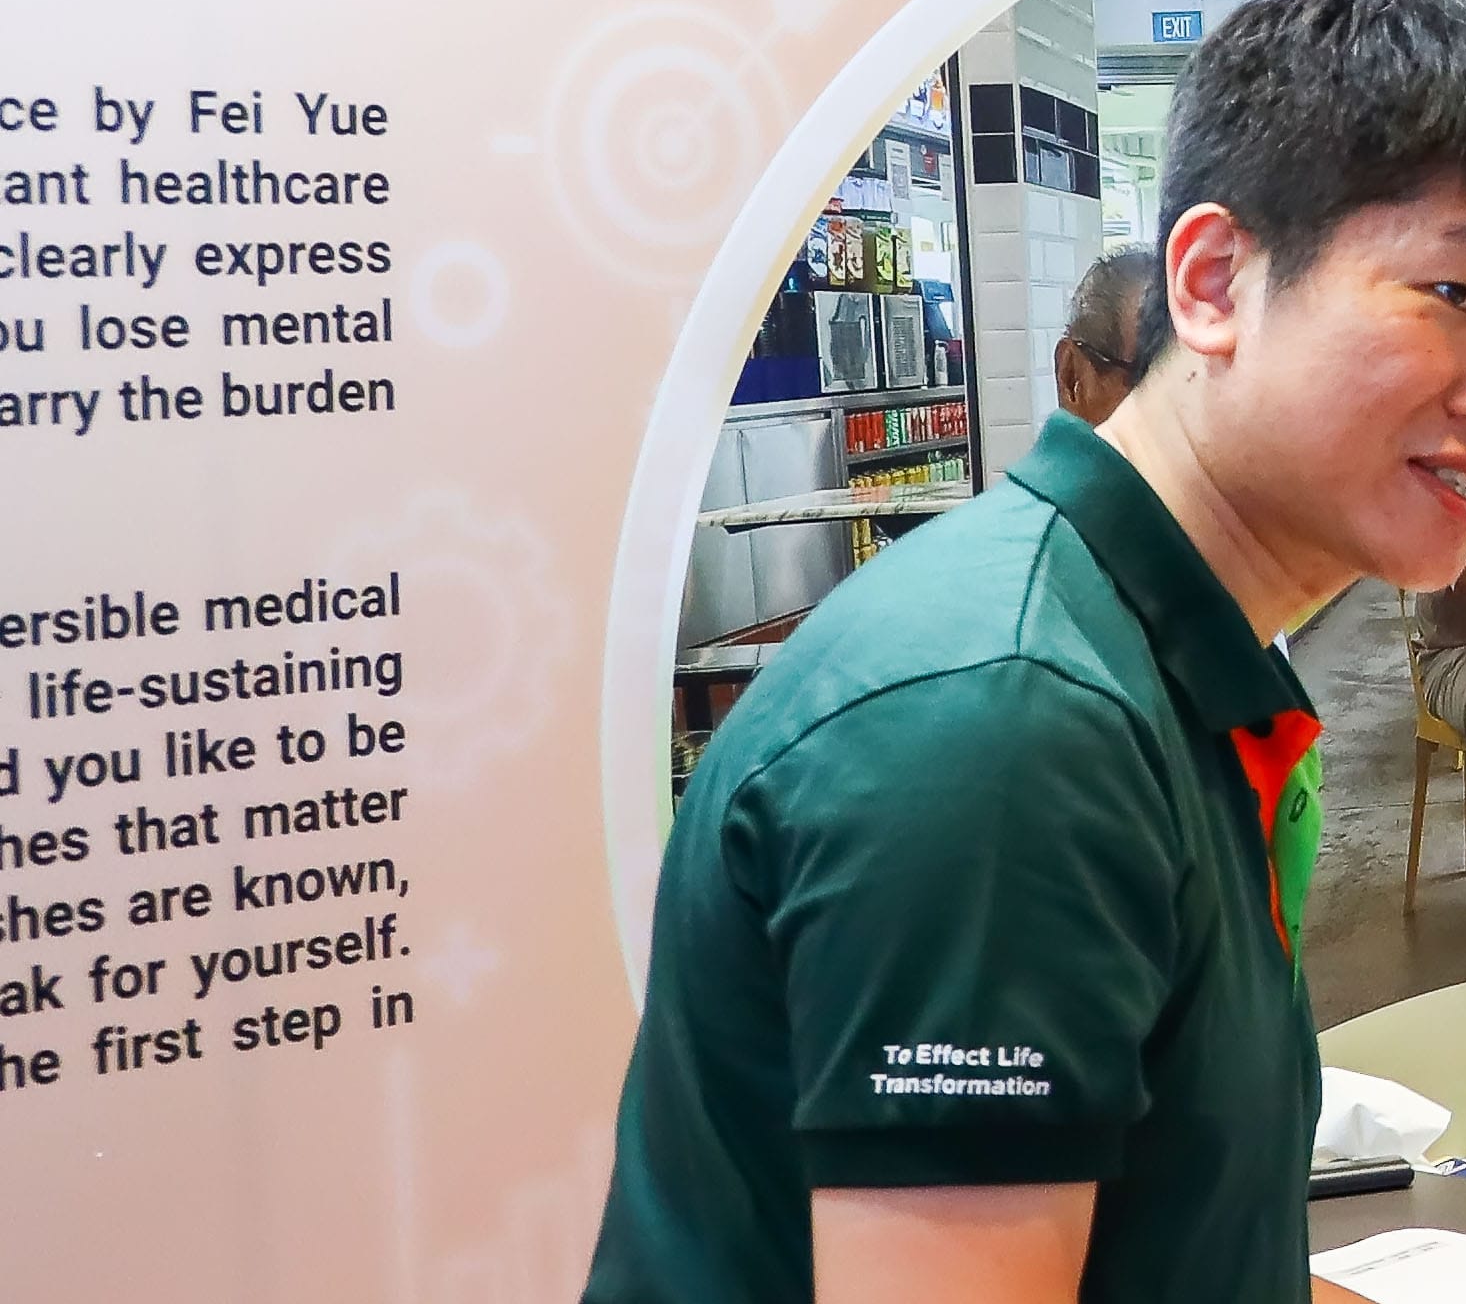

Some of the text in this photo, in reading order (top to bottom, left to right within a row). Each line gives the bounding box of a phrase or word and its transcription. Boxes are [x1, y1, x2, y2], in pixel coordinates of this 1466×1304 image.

[1162, 16, 1192, 38] EXIT
[94, 86, 154, 145] by
[190, 90, 262, 134] Fei
[295, 92, 388, 136] Yue
[120, 158, 390, 205] healthcare
[194, 241, 392, 287] express
[80, 304, 190, 351] lose
[222, 297, 392, 347] mental
[117, 374, 204, 422] the
[222, 368, 395, 418] burden
[204, 571, 400, 632] medical
[29, 646, 402, 720] life-sustaining
[43, 748, 141, 804] you
[165, 728, 257, 778] like
[276, 725, 326, 765] to
[347, 712, 406, 758] be
[113, 804, 221, 855] that
[244, 787, 408, 840] matter
[128, 883, 213, 926] are
[233, 858, 409, 912] known,
[88, 954, 166, 1003] for
[189, 912, 411, 1000] yourself.
[90, 1018, 203, 1075] first
[232, 1003, 341, 1052] step
[371, 985, 414, 1029] in
[882, 1043, 1044, 1069] To Effect Life
[869, 1073, 1050, 1096] Transformation
